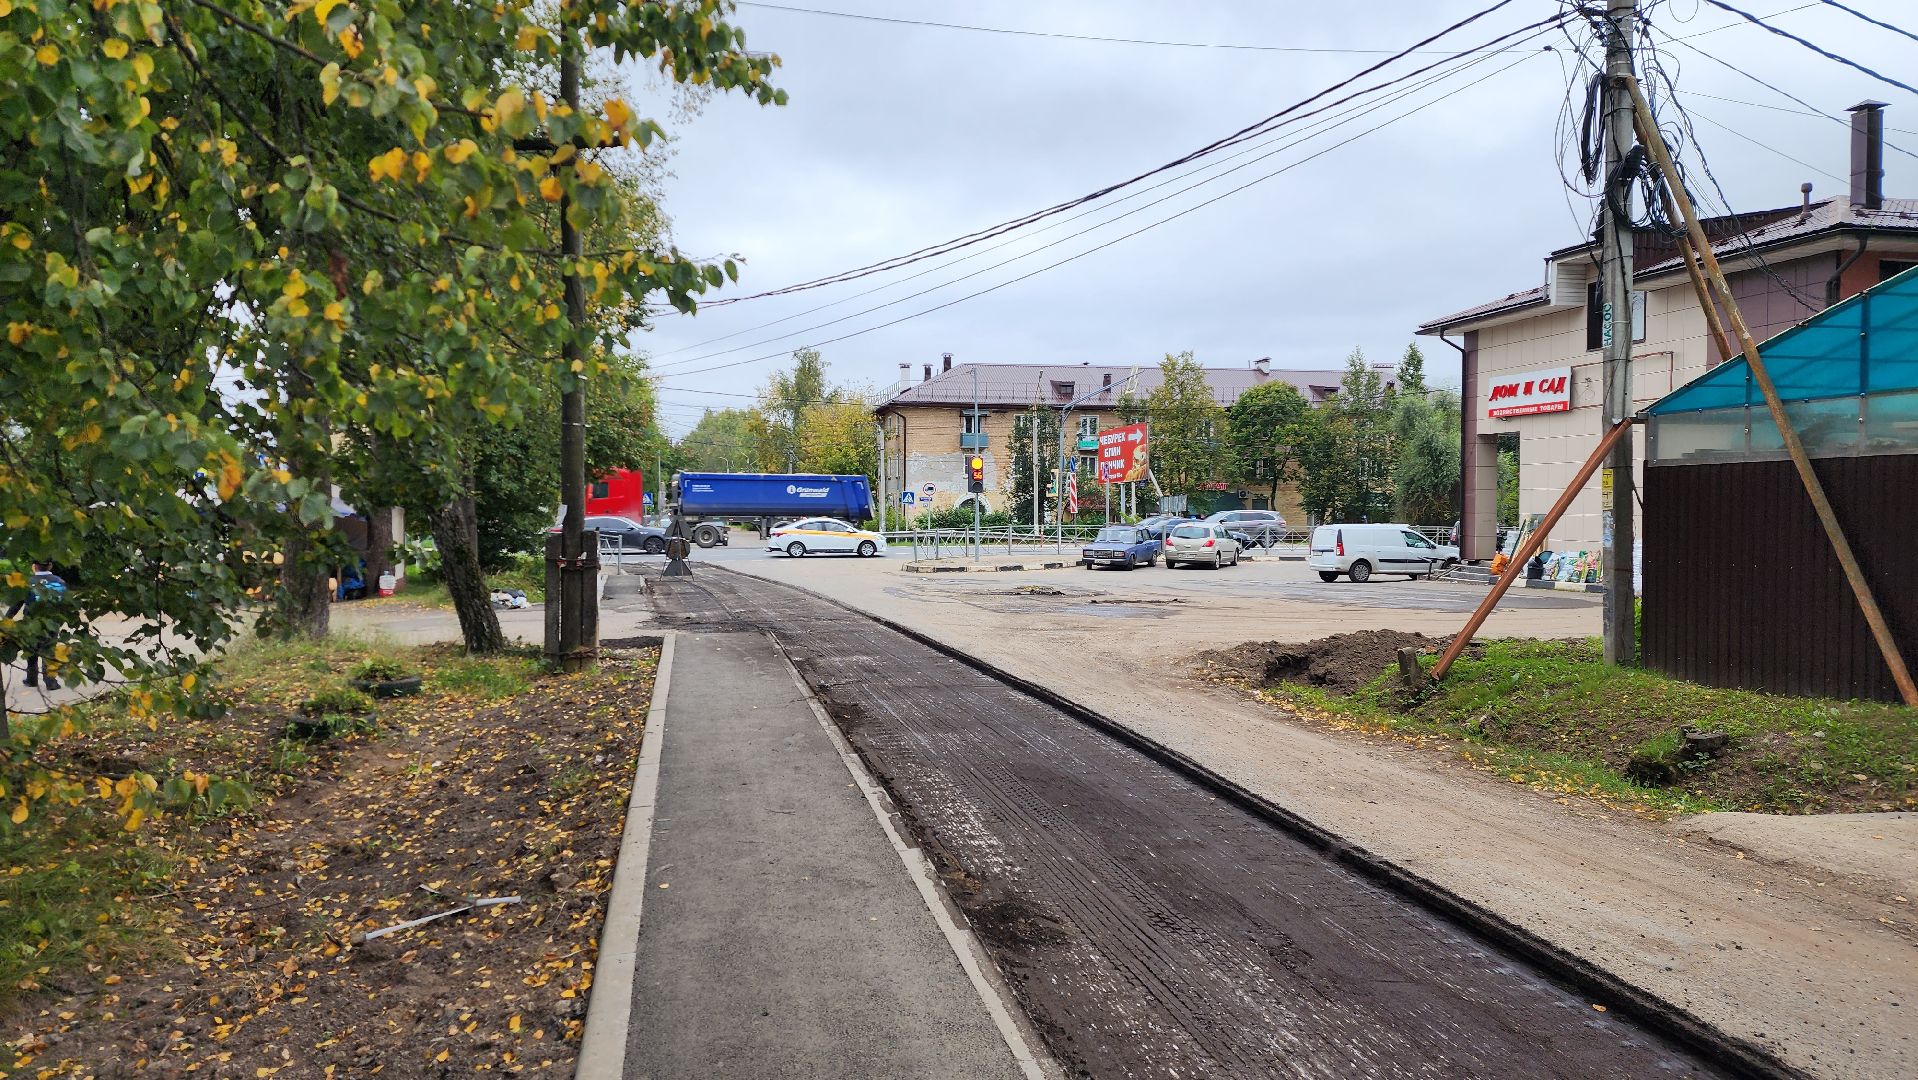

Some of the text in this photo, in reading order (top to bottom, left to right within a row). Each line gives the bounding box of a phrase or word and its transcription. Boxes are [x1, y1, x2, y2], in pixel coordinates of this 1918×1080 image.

[1603, 303, 1612, 347] НАСОС
[1489, 376, 1567, 401] ДОМ И САД
[1539, 403, 1564, 411] ТОВАРЫ
[1099, 432, 1126, 445] ЧЕБУРЕК
[1104, 446, 1121, 458] БЛИН
[1100, 459, 1125, 471] ПНЧИК
